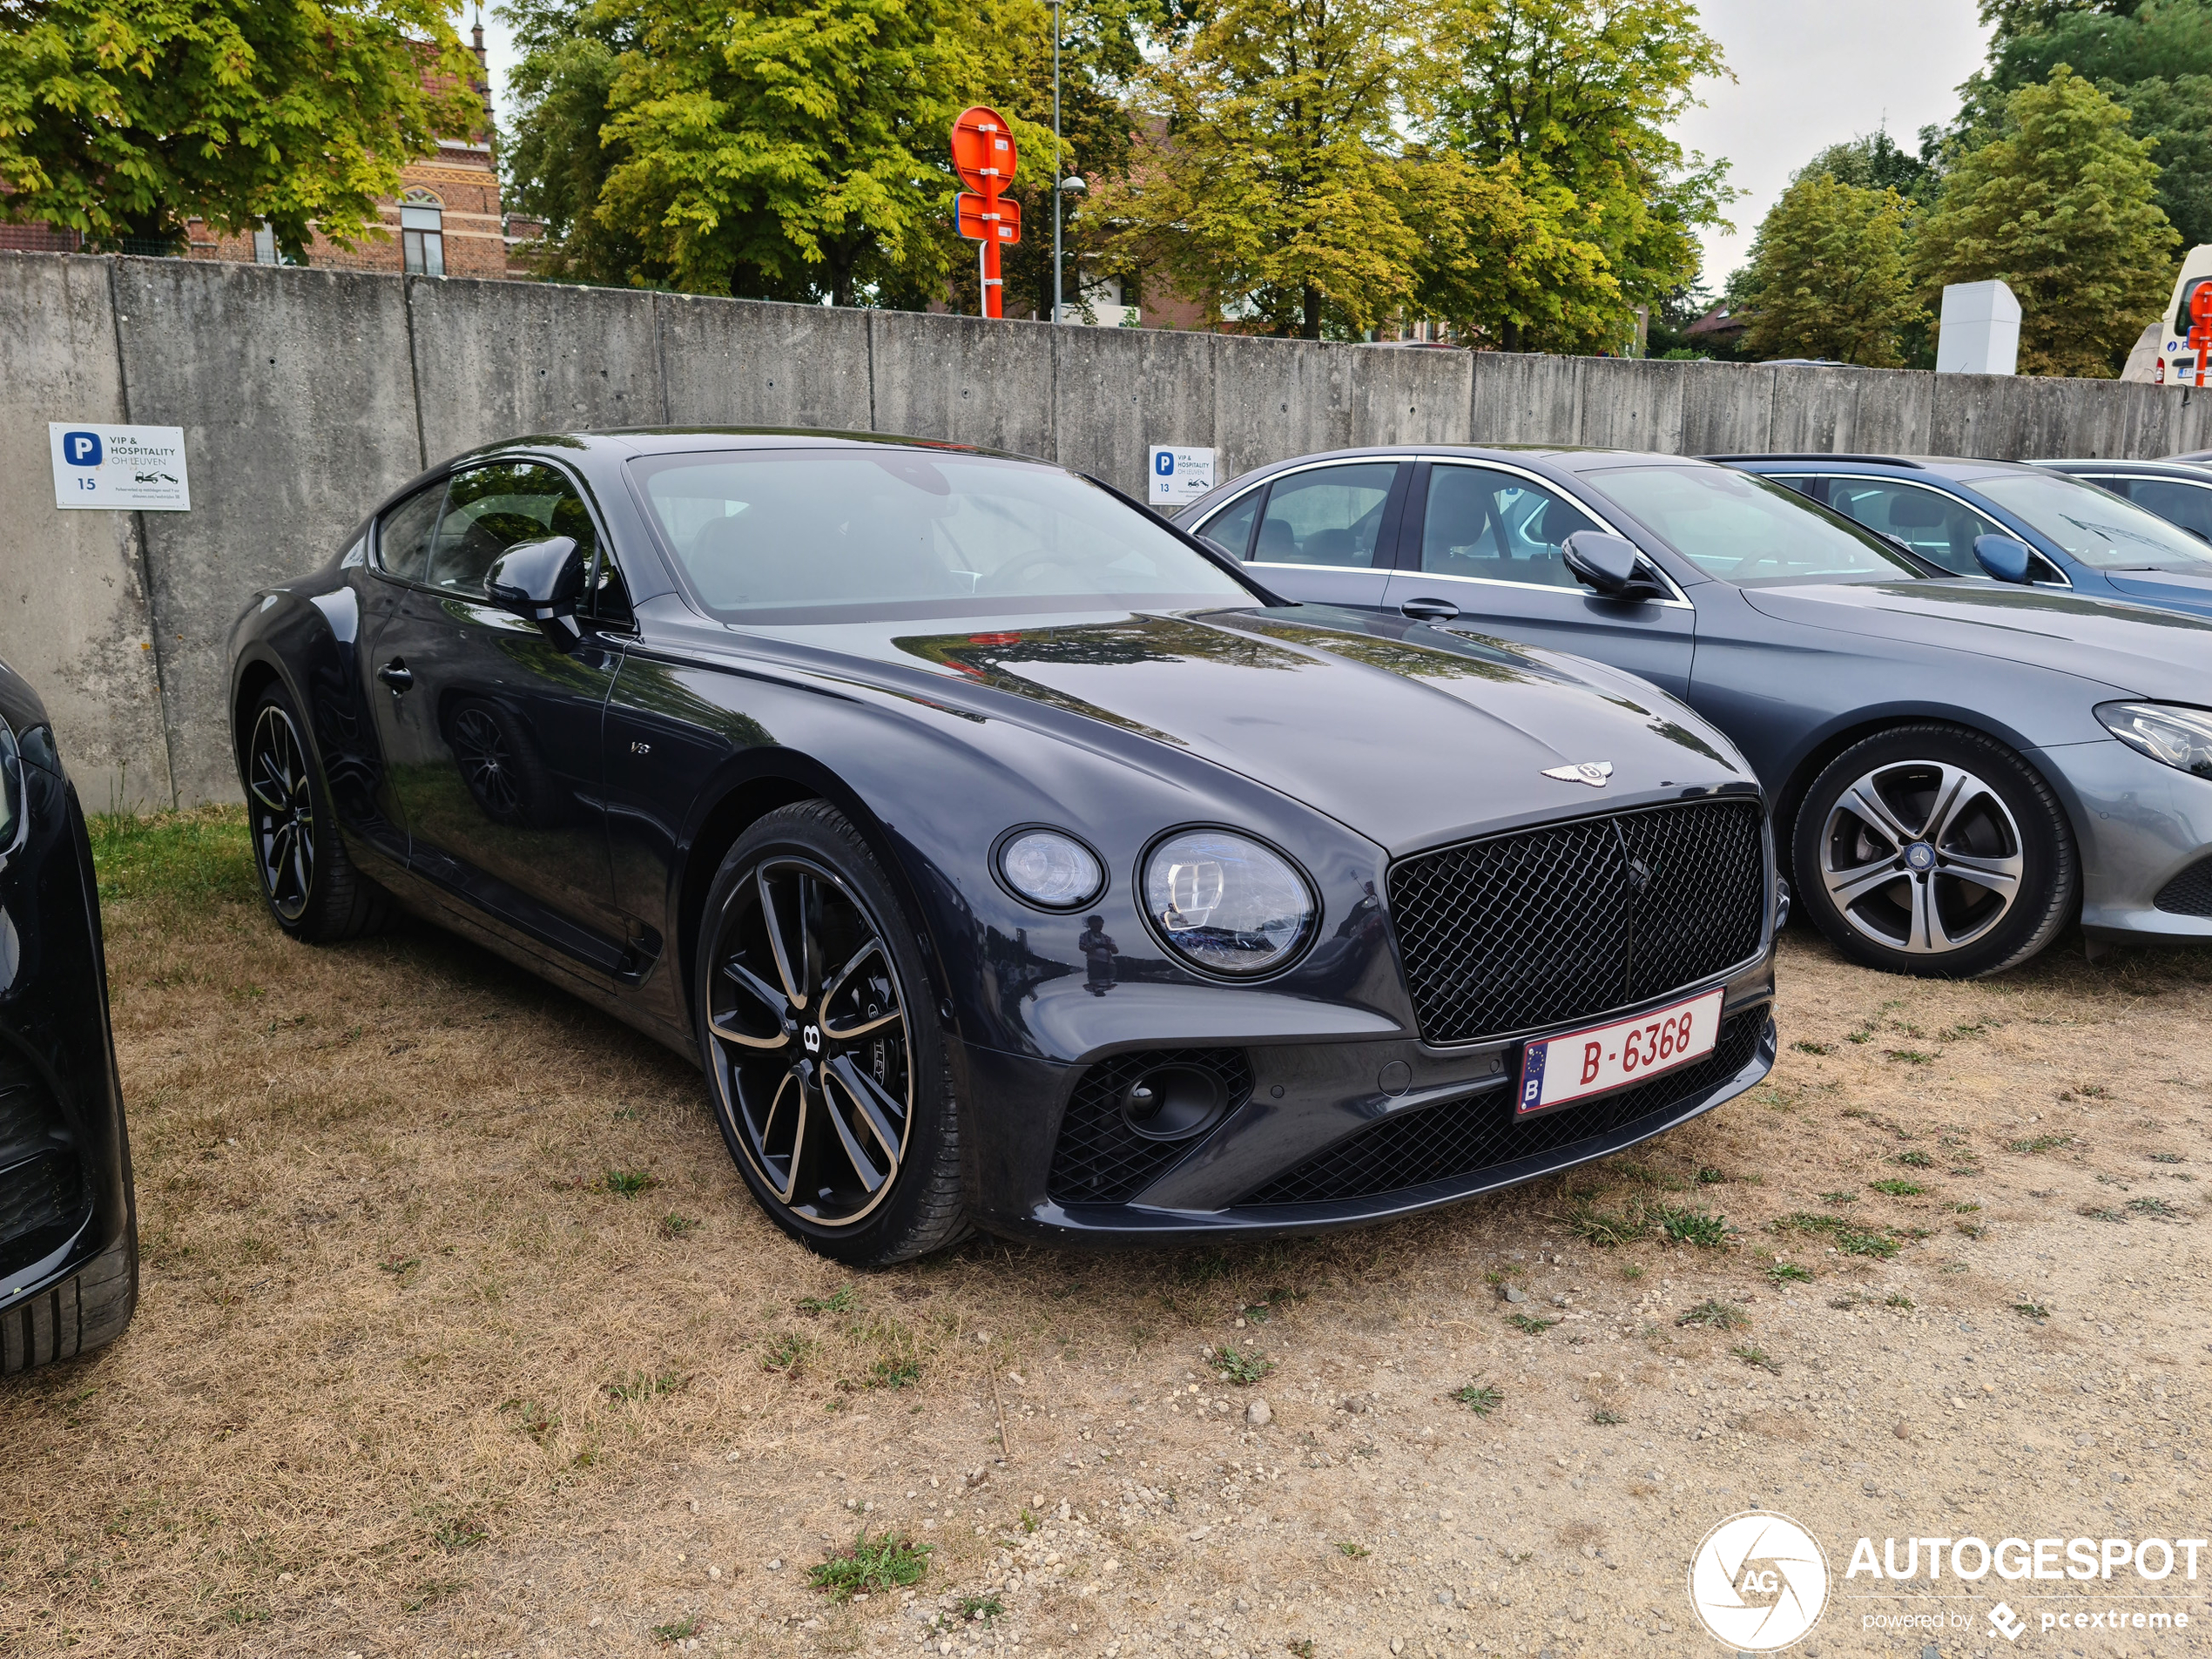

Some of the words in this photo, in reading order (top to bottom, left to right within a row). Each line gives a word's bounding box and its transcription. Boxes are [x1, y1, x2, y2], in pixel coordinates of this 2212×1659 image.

[75, 437, 93, 460] P
[111, 447, 175, 456] HOSPITALITY
[111, 456, 128, 465] OH
[131, 457, 166, 466] LEUVEN
[1161, 455, 1170, 471] P
[78, 477, 96, 490] 15
[1160, 483, 1170, 492] 13
[631, 741, 651, 754] V8
[1580, 1011, 1693, 1086] B-6368
[1524, 1079, 1540, 1102] B
